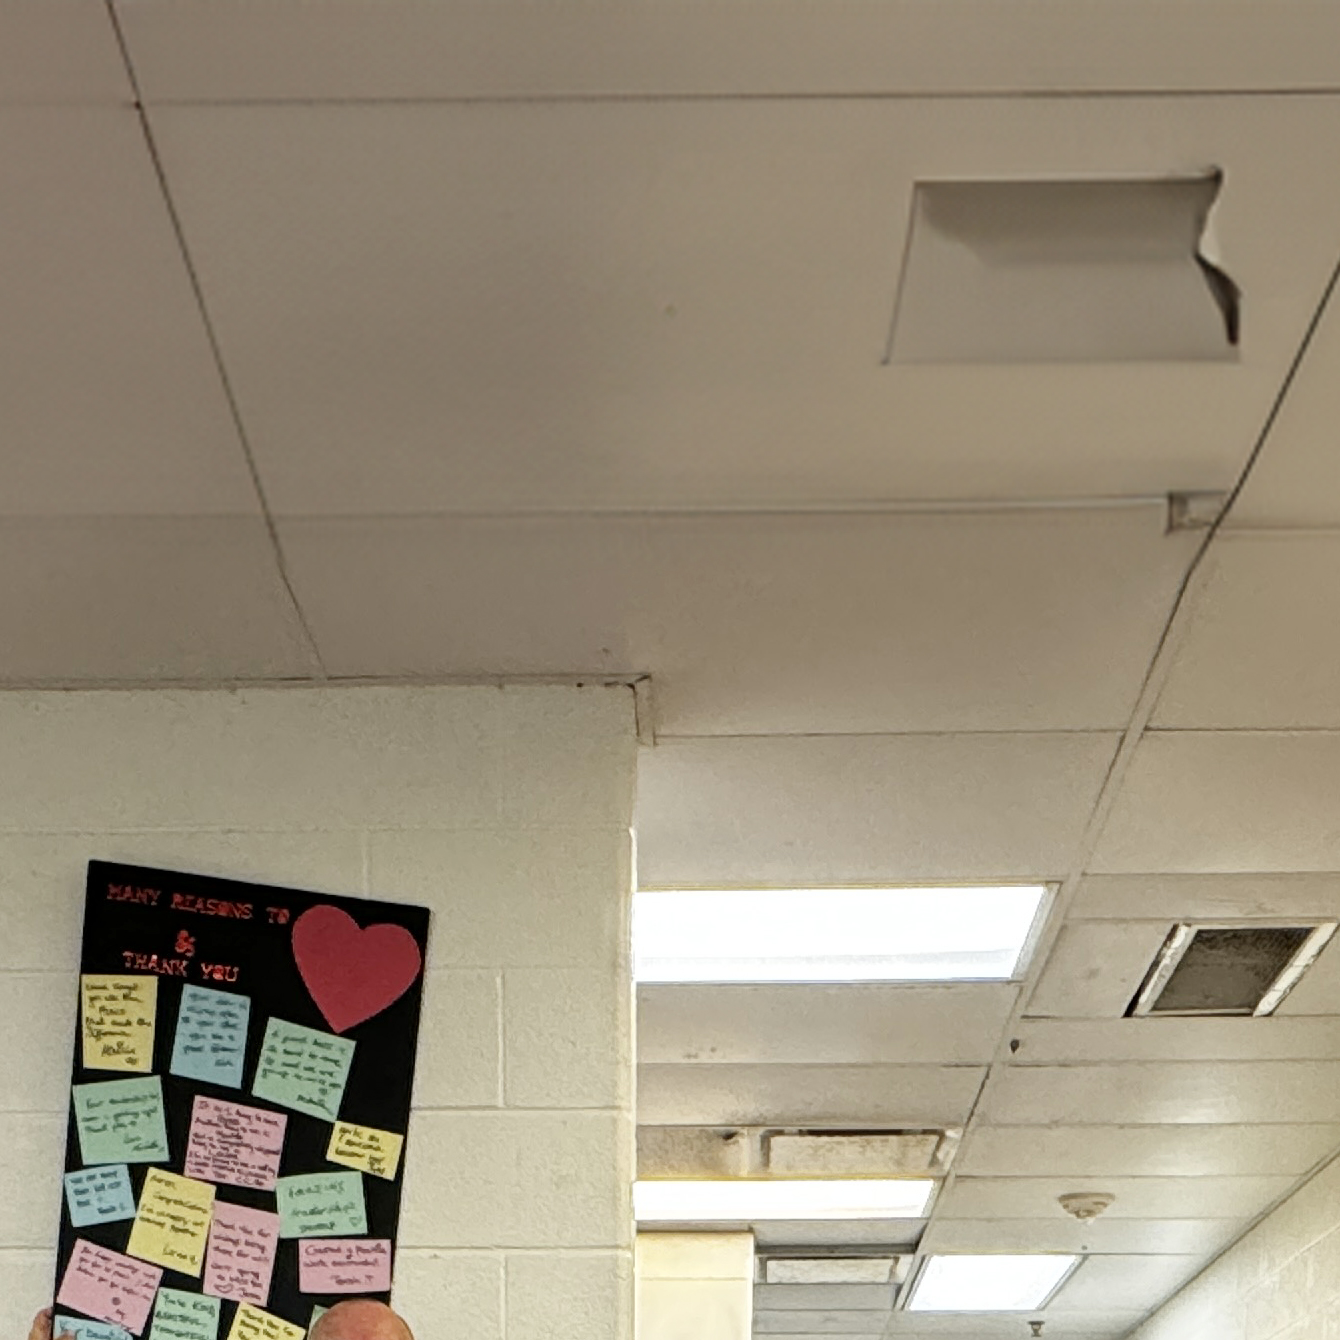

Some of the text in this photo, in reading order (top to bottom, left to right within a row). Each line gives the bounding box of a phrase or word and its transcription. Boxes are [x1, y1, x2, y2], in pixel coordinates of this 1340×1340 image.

[107, 883, 290, 925] MANY REASONS TO
[174, 929, 196, 957] &
[122, 950, 240, 982] THANK YOU
